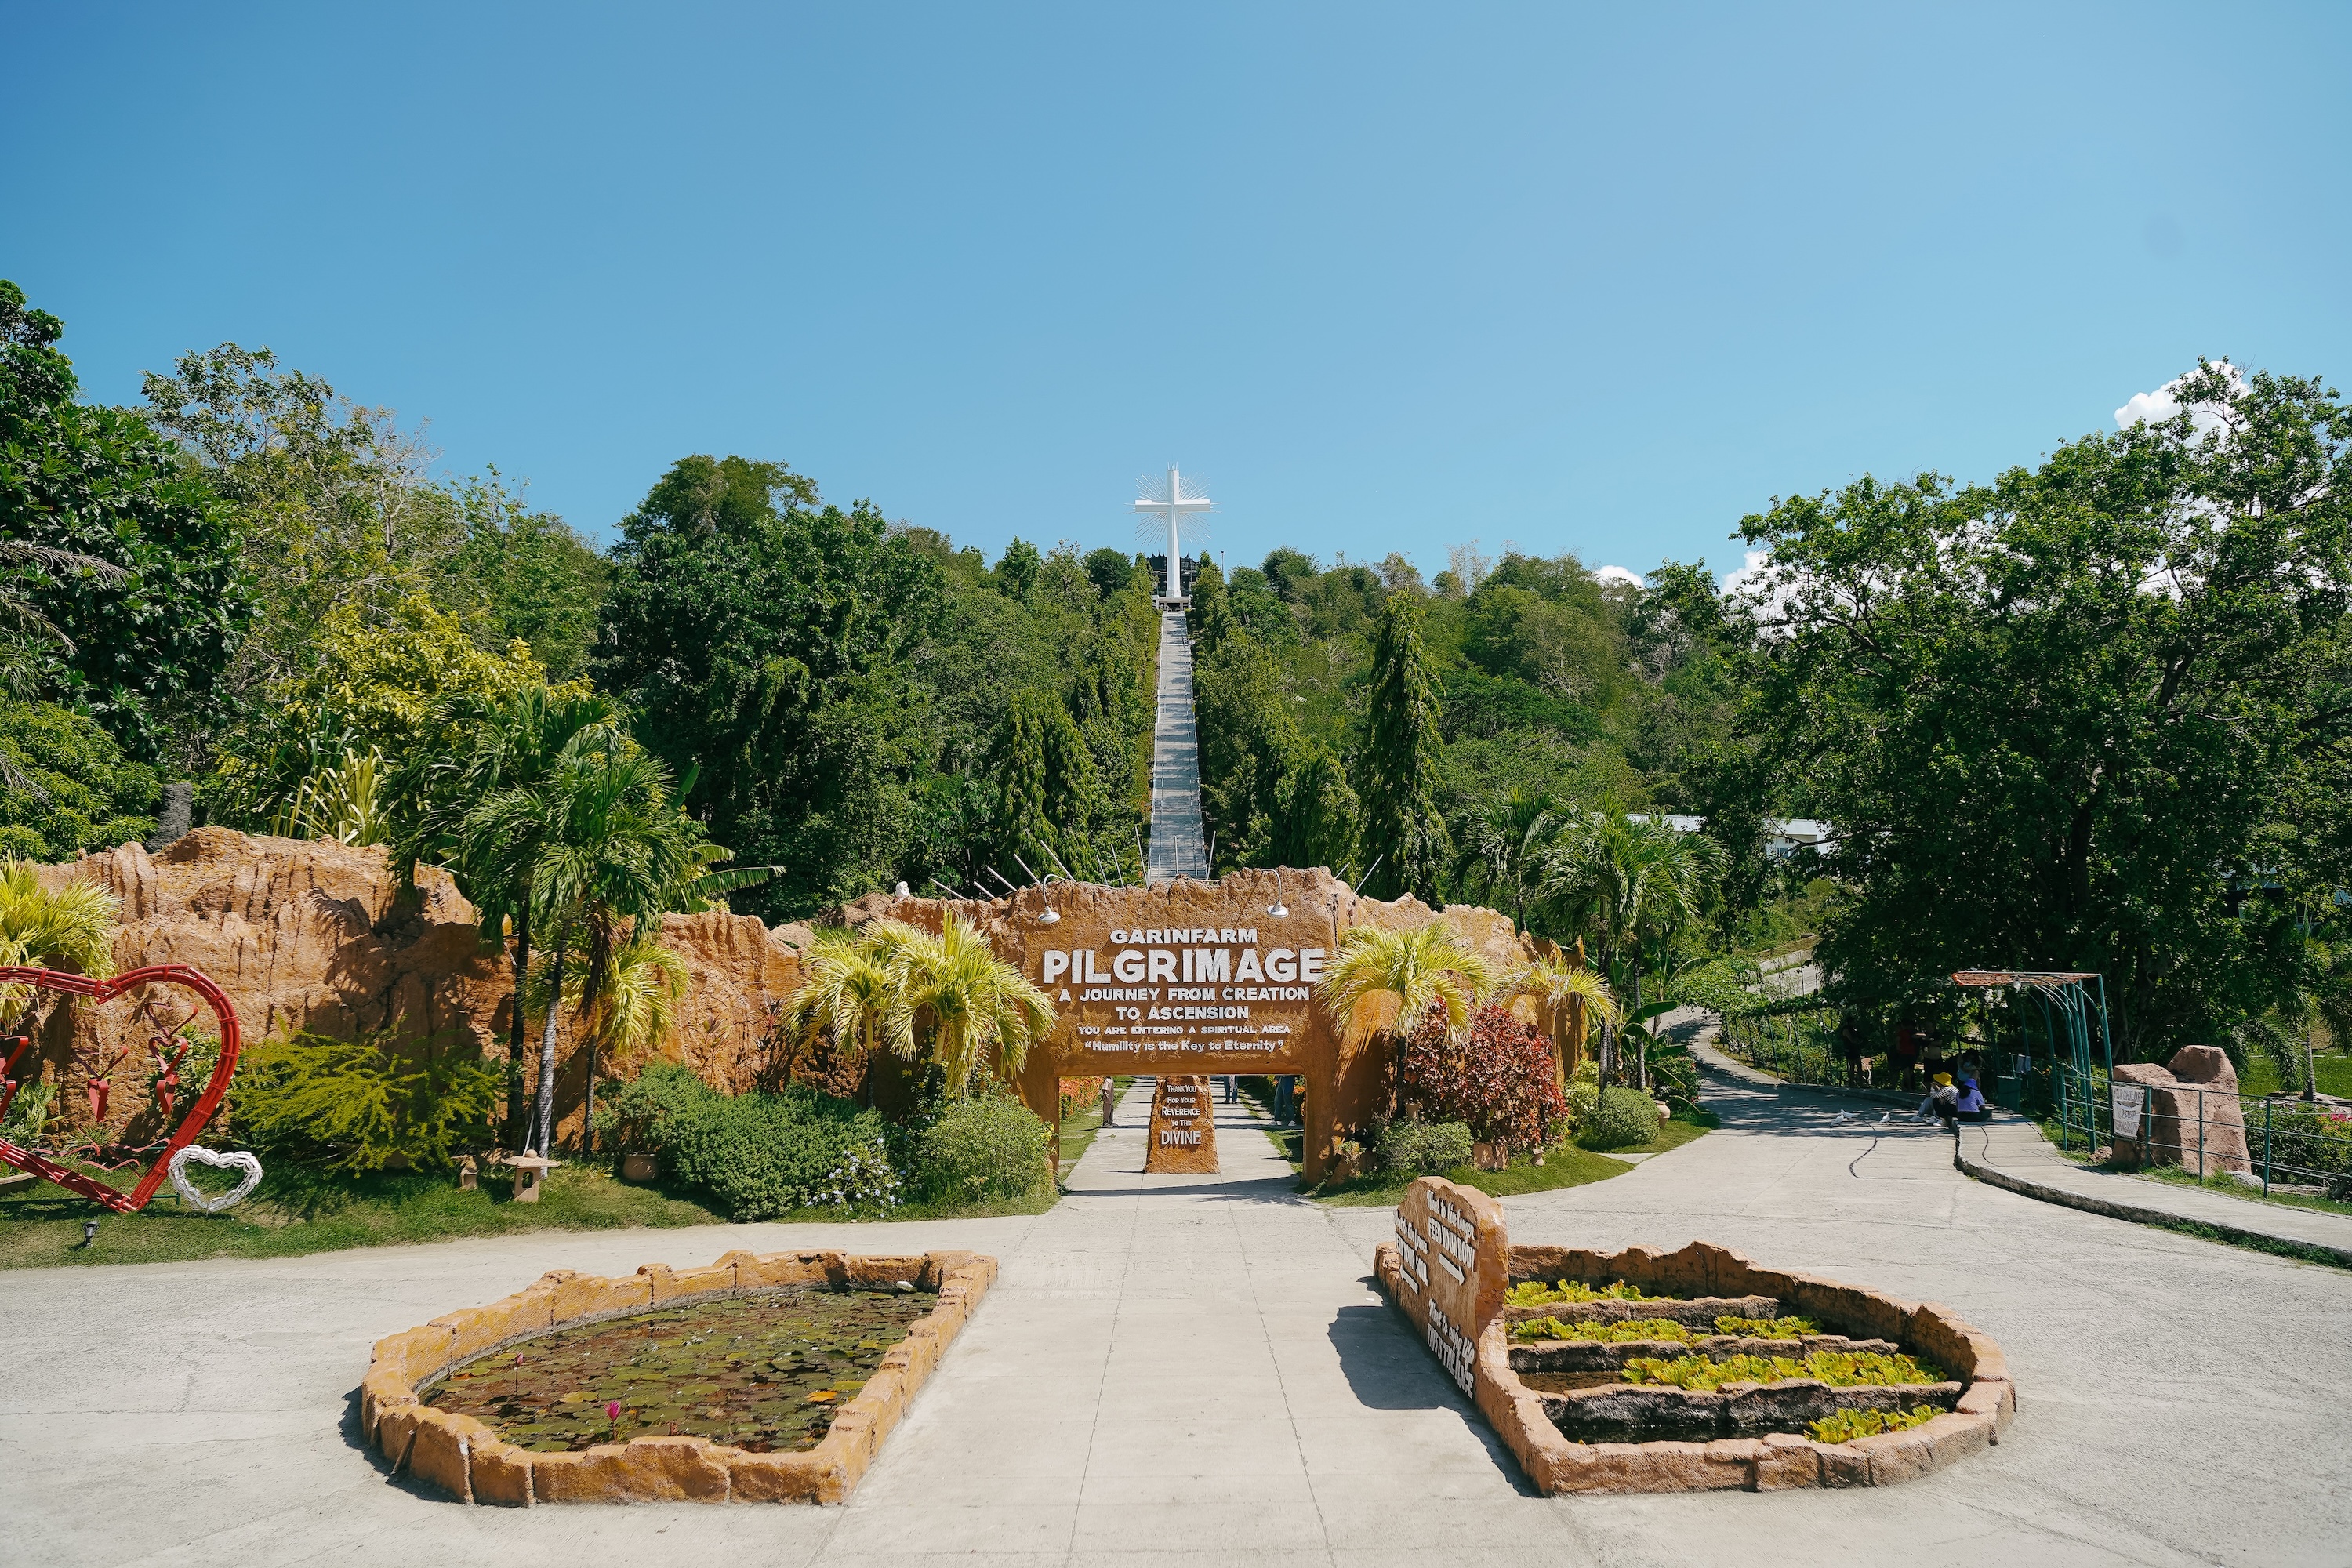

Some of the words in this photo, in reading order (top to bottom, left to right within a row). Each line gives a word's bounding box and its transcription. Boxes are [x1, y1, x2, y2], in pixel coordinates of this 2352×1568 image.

[1110, 928, 1258, 944] GARINFARM
[1044, 948, 1325, 984] PILGRIMAGE
[1059, 989, 1071, 1002] A
[1080, 988, 1160, 1002] JOURNEY
[1167, 987, 1215, 1001] FROM
[1222, 986, 1309, 1000] CREATION
[1116, 1007, 1139, 1020] TO
[1147, 1006, 1248, 1020] ASCENSION
[1078, 1026, 1100, 1035] YOU
[1105, 1026, 1127, 1035] ARE
[1131, 1026, 1183, 1035] ENTERING
[1201, 1025, 1256, 1034] SPIRITUAL
[1145, 1040, 1155, 1051] is
[1158, 1040, 1178, 1051] the
[1181, 1040, 1205, 1053] Key
[1208, 1040, 1221, 1051] to
[1162, 1106, 1200, 1116] REVERENCE
[1161, 1131, 1201, 1145] DIVINE
[1428, 1217, 1441, 1244] FEED
[1442, 1225, 1457, 1258] YOUR
[1457, 1237, 1475, 1272] BODY
[1443, 1342, 1455, 1376] THE
